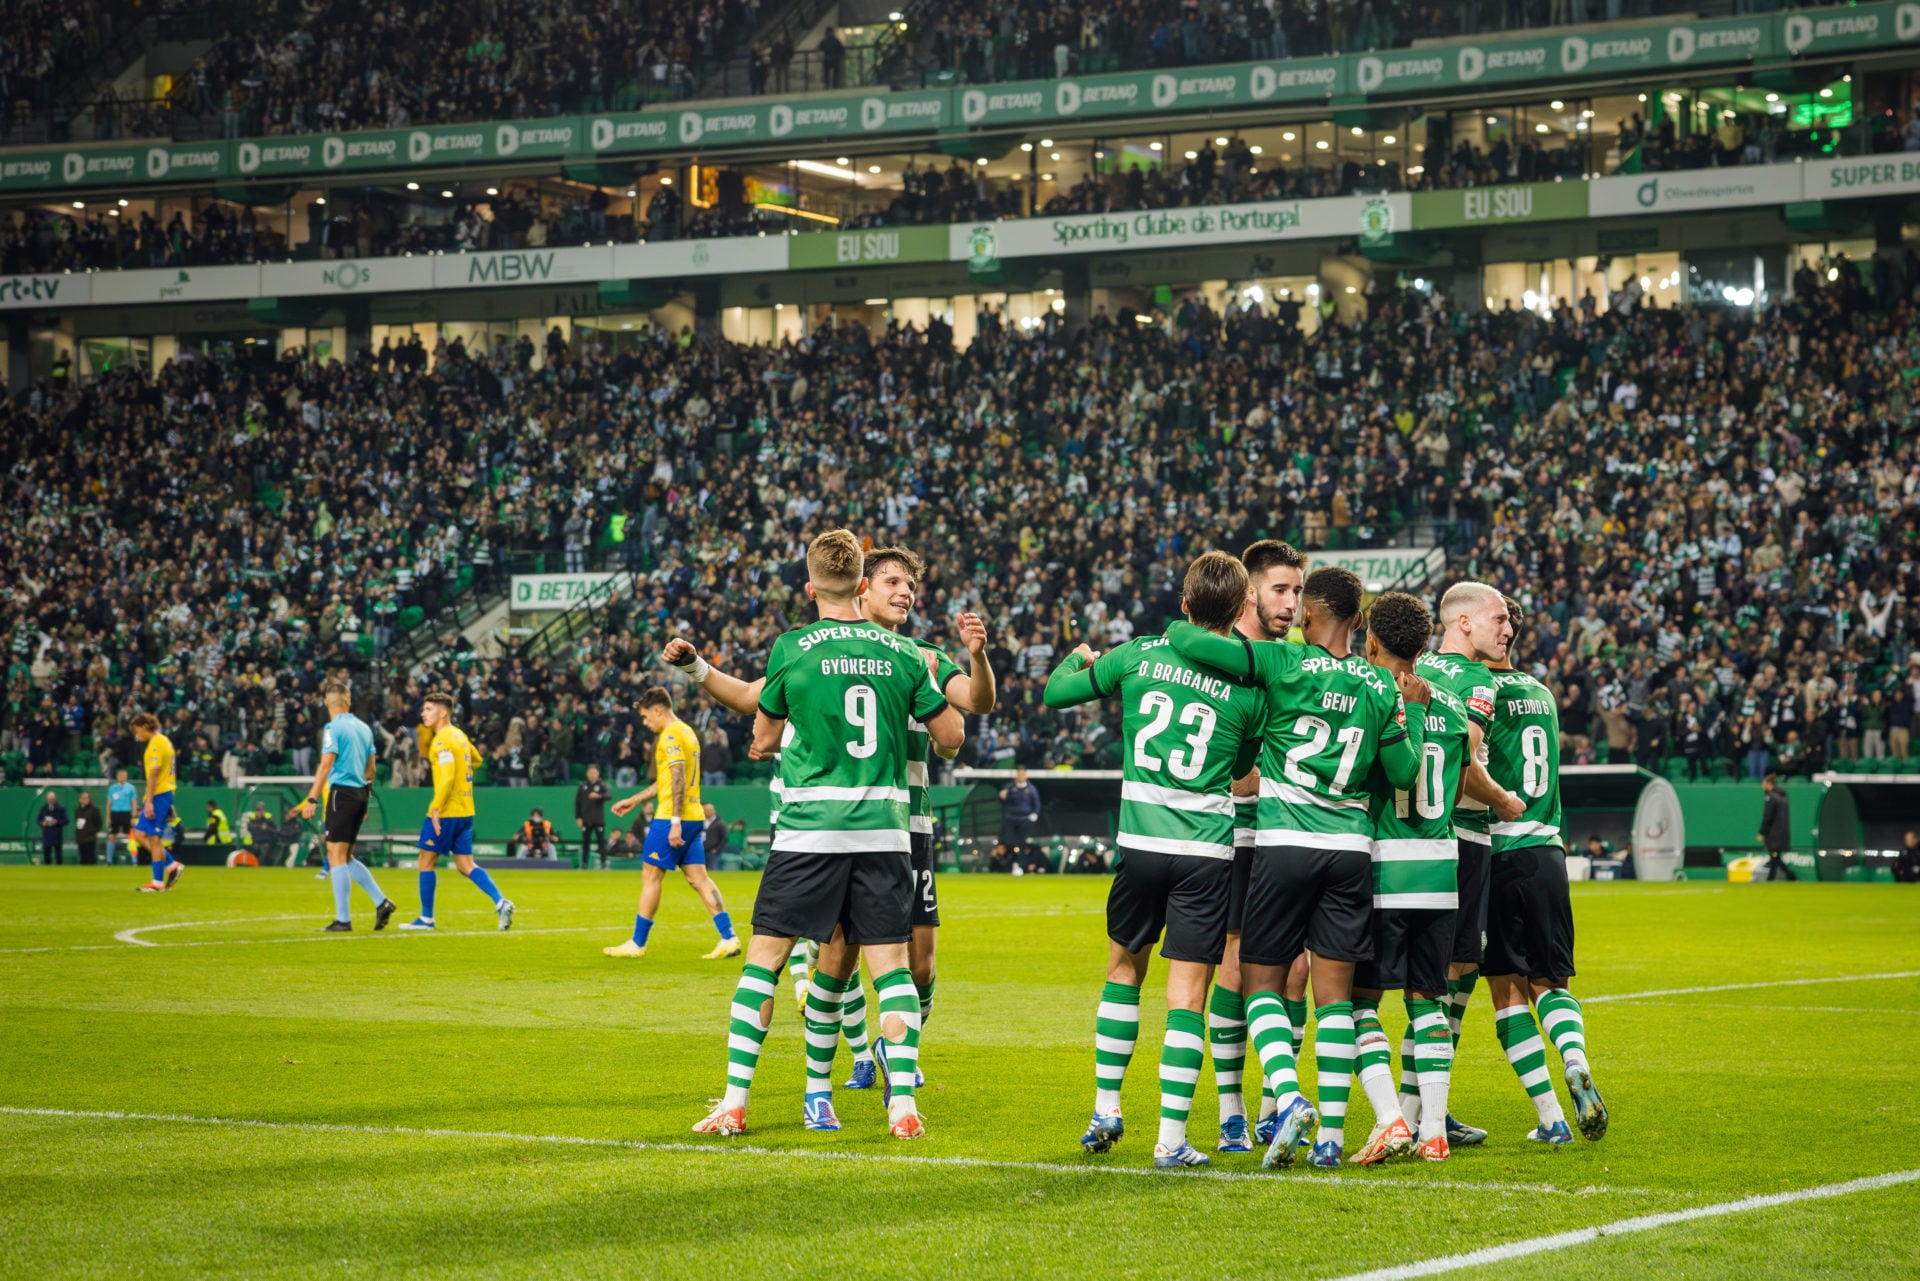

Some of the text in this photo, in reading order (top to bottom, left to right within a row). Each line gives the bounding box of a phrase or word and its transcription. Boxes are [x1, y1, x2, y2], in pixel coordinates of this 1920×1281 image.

[1816, 14, 1878, 36] BETANO
[1699, 27, 1760, 48] BETANO
[1487, 48, 1545, 68] BETANO
[1591, 38, 1651, 58] BETANO
[1279, 68, 1336, 87] BETANO
[1386, 58, 1444, 77] BETANO
[1084, 84, 1137, 102] BETANO
[1180, 76, 1235, 95] BETANO
[888, 100, 942, 118] BETANO
[989, 92, 1042, 110] BETANO
[705, 114, 756, 132] BETANO
[795, 107, 847, 125] BETANO
[521, 127, 572, 145] BETANO
[617, 121, 666, 139] BETANO
[348, 140, 396, 157] BETANO
[434, 134, 483, 151] BETANO
[171, 151, 219, 167] BETANO
[262, 145, 310, 162] BETANO
[4, 161, 51, 176] BETANO
[87, 156, 134, 172] BETANO
[1831, 163, 1896, 188] SUPER
[1465, 188, 1532, 220] EU SOU
[1053, 205, 1300, 246] Sporting Clube de Portugal
[838, 233, 899, 262] EU SOU
[323, 262, 370, 289] NOS
[469, 253, 554, 283] MBW
[798, 626, 901, 653] SUPER BOCK
[821, 655, 892, 677] GYÖKERES
[1424, 655, 1463, 680] BOCK
[1139, 660, 1232, 702] D. BRAGANÇA
[1322, 691, 1358, 715] GENY
[1508, 699, 1543, 717] PEDRO
[844, 685, 877, 759] 9
[1134, 691, 1217, 781] 23
[1284, 715, 1365, 796] 21
[1522, 725, 1548, 798] 8
